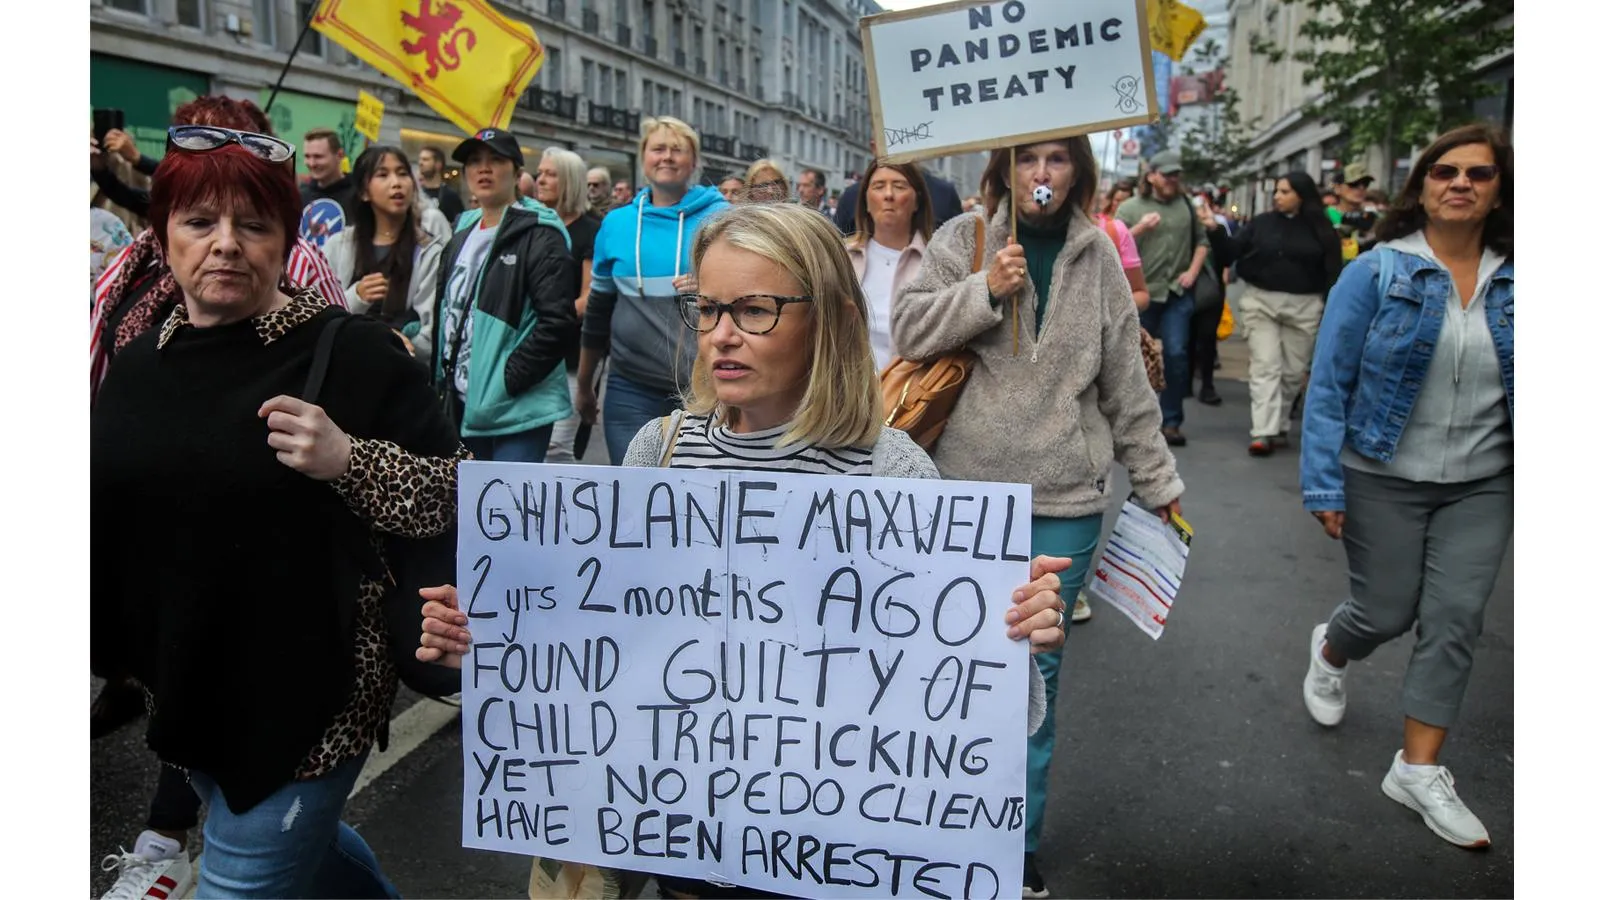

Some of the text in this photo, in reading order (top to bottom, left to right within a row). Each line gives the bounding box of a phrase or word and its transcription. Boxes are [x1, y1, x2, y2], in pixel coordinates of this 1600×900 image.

[910, 17, 1123, 72] PANDEMIC
[968, 0, 1026, 30] NO
[922, 65, 1077, 112] TREATY
[476, 478, 1030, 562] GHISLANE MAXWELL
[467, 554, 986, 646] 2 yrs 2 months AGO
[473, 635, 1007, 722] FOUND GUILTY OF
[477, 697, 993, 780] CHILD TRAFFICKING
[472, 751, 1025, 832] YET NO PEDO CLIENTS
[476, 798, 999, 899] HAVE BEEN ARRESTED
